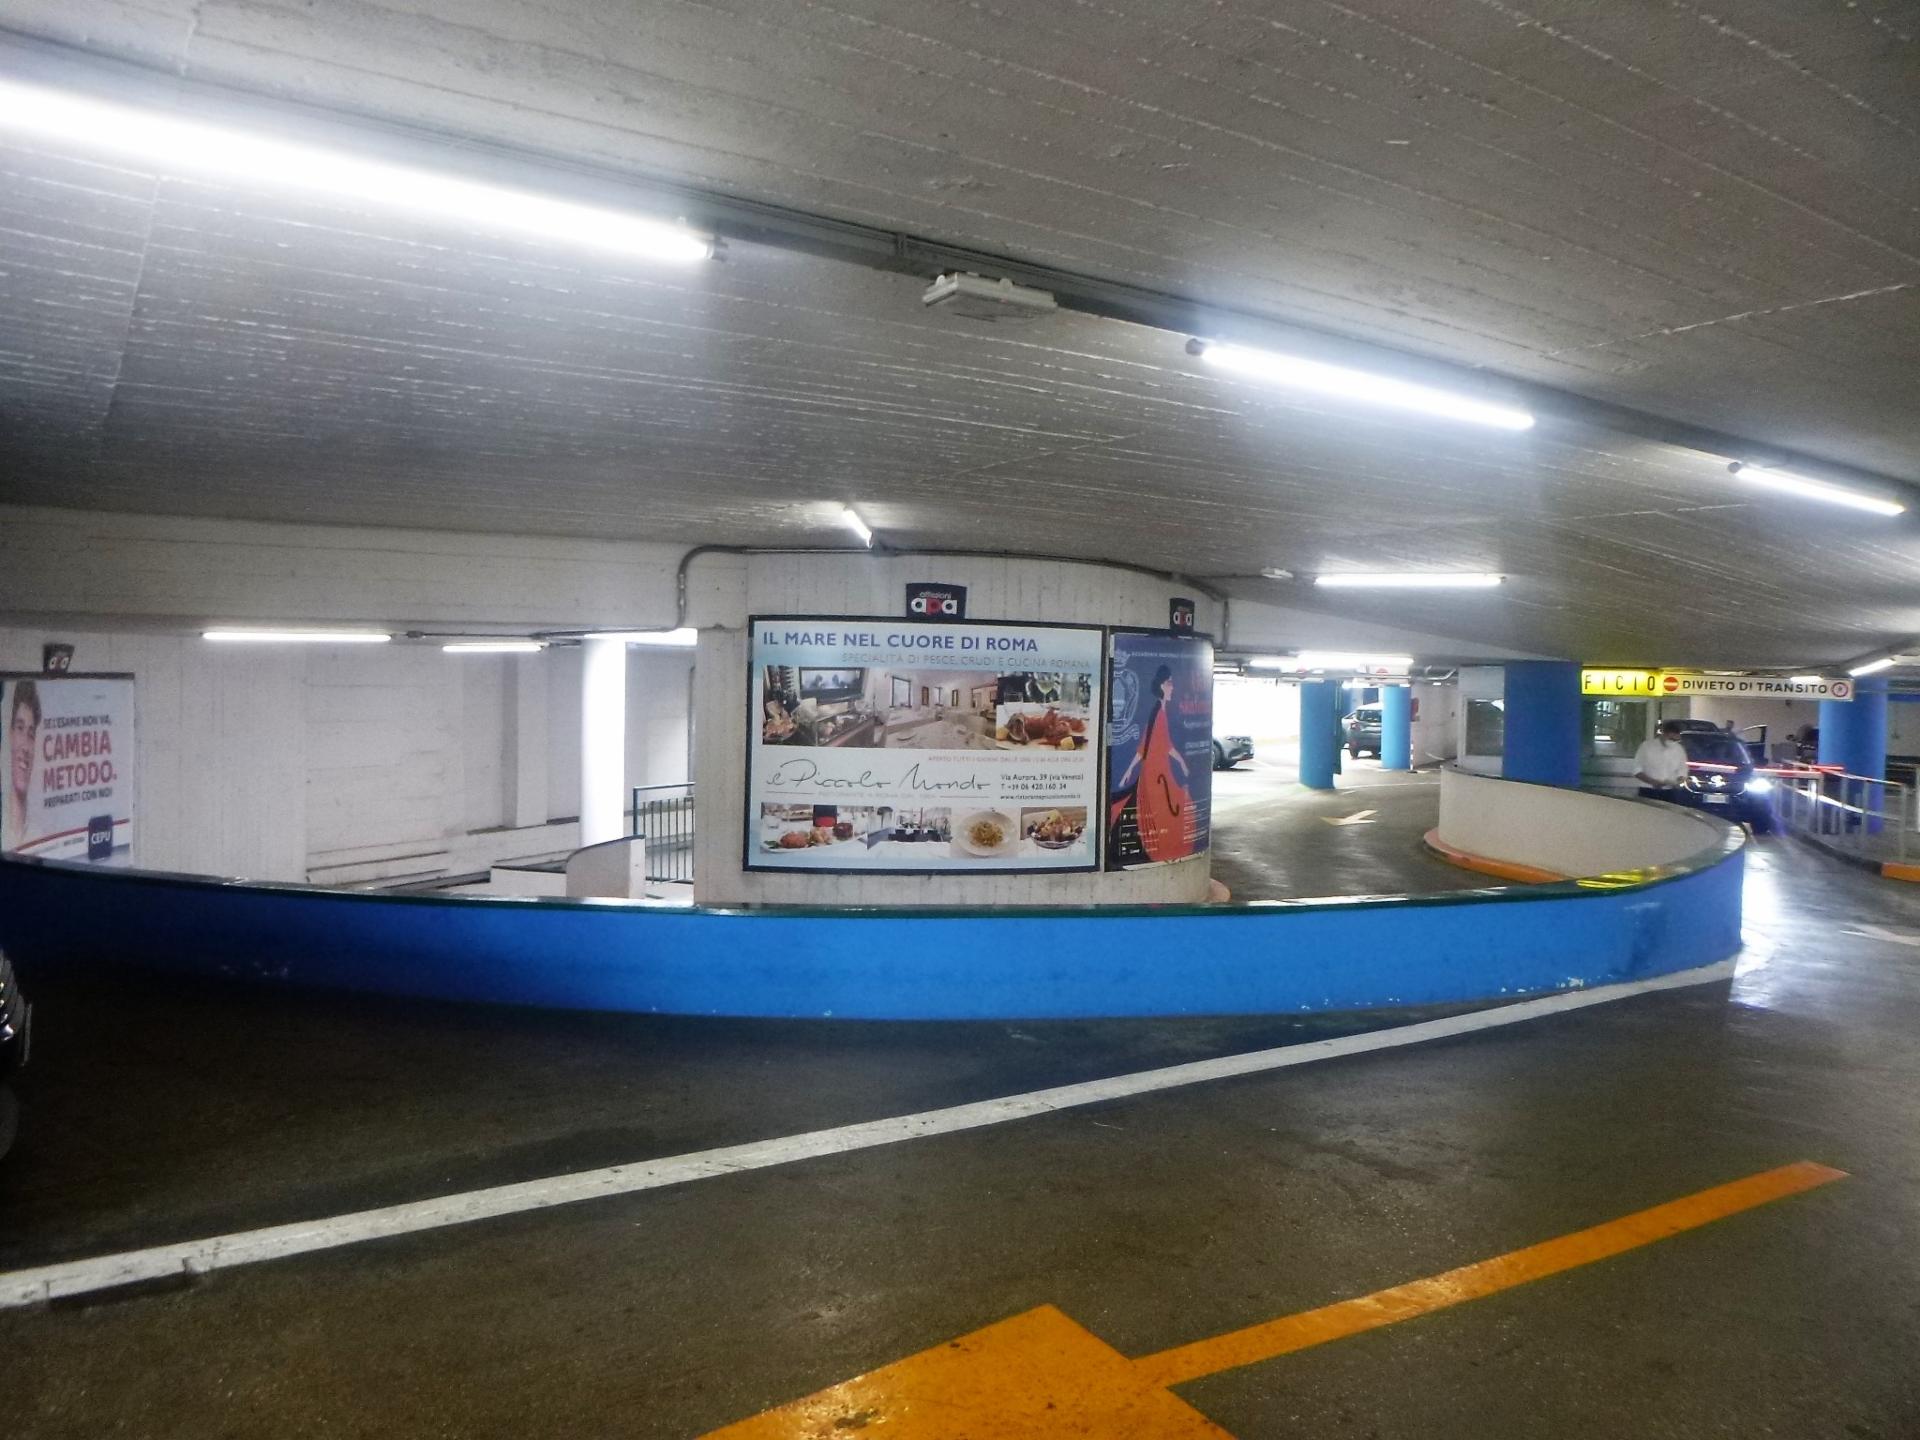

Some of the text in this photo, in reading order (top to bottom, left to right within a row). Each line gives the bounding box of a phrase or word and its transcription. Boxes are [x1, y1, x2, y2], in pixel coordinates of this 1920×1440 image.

[763, 632, 1038, 651] IL MARE NEL CUORE DI ROMA
[908, 654, 920, 664] DI
[1008, 657, 1046, 667] CUCINA
[1682, 680, 1828, 694] DIVIETO DI TRANSITO
[82, 715, 98, 726] NON
[43, 730, 112, 762] CAMBIA
[43, 760, 117, 792] METODO.
[780, 758, 891, 788] Piccolo
[899, 763, 990, 790] Mondo
[82, 790, 97, 801] CON
[91, 831, 111, 845] CEPU
